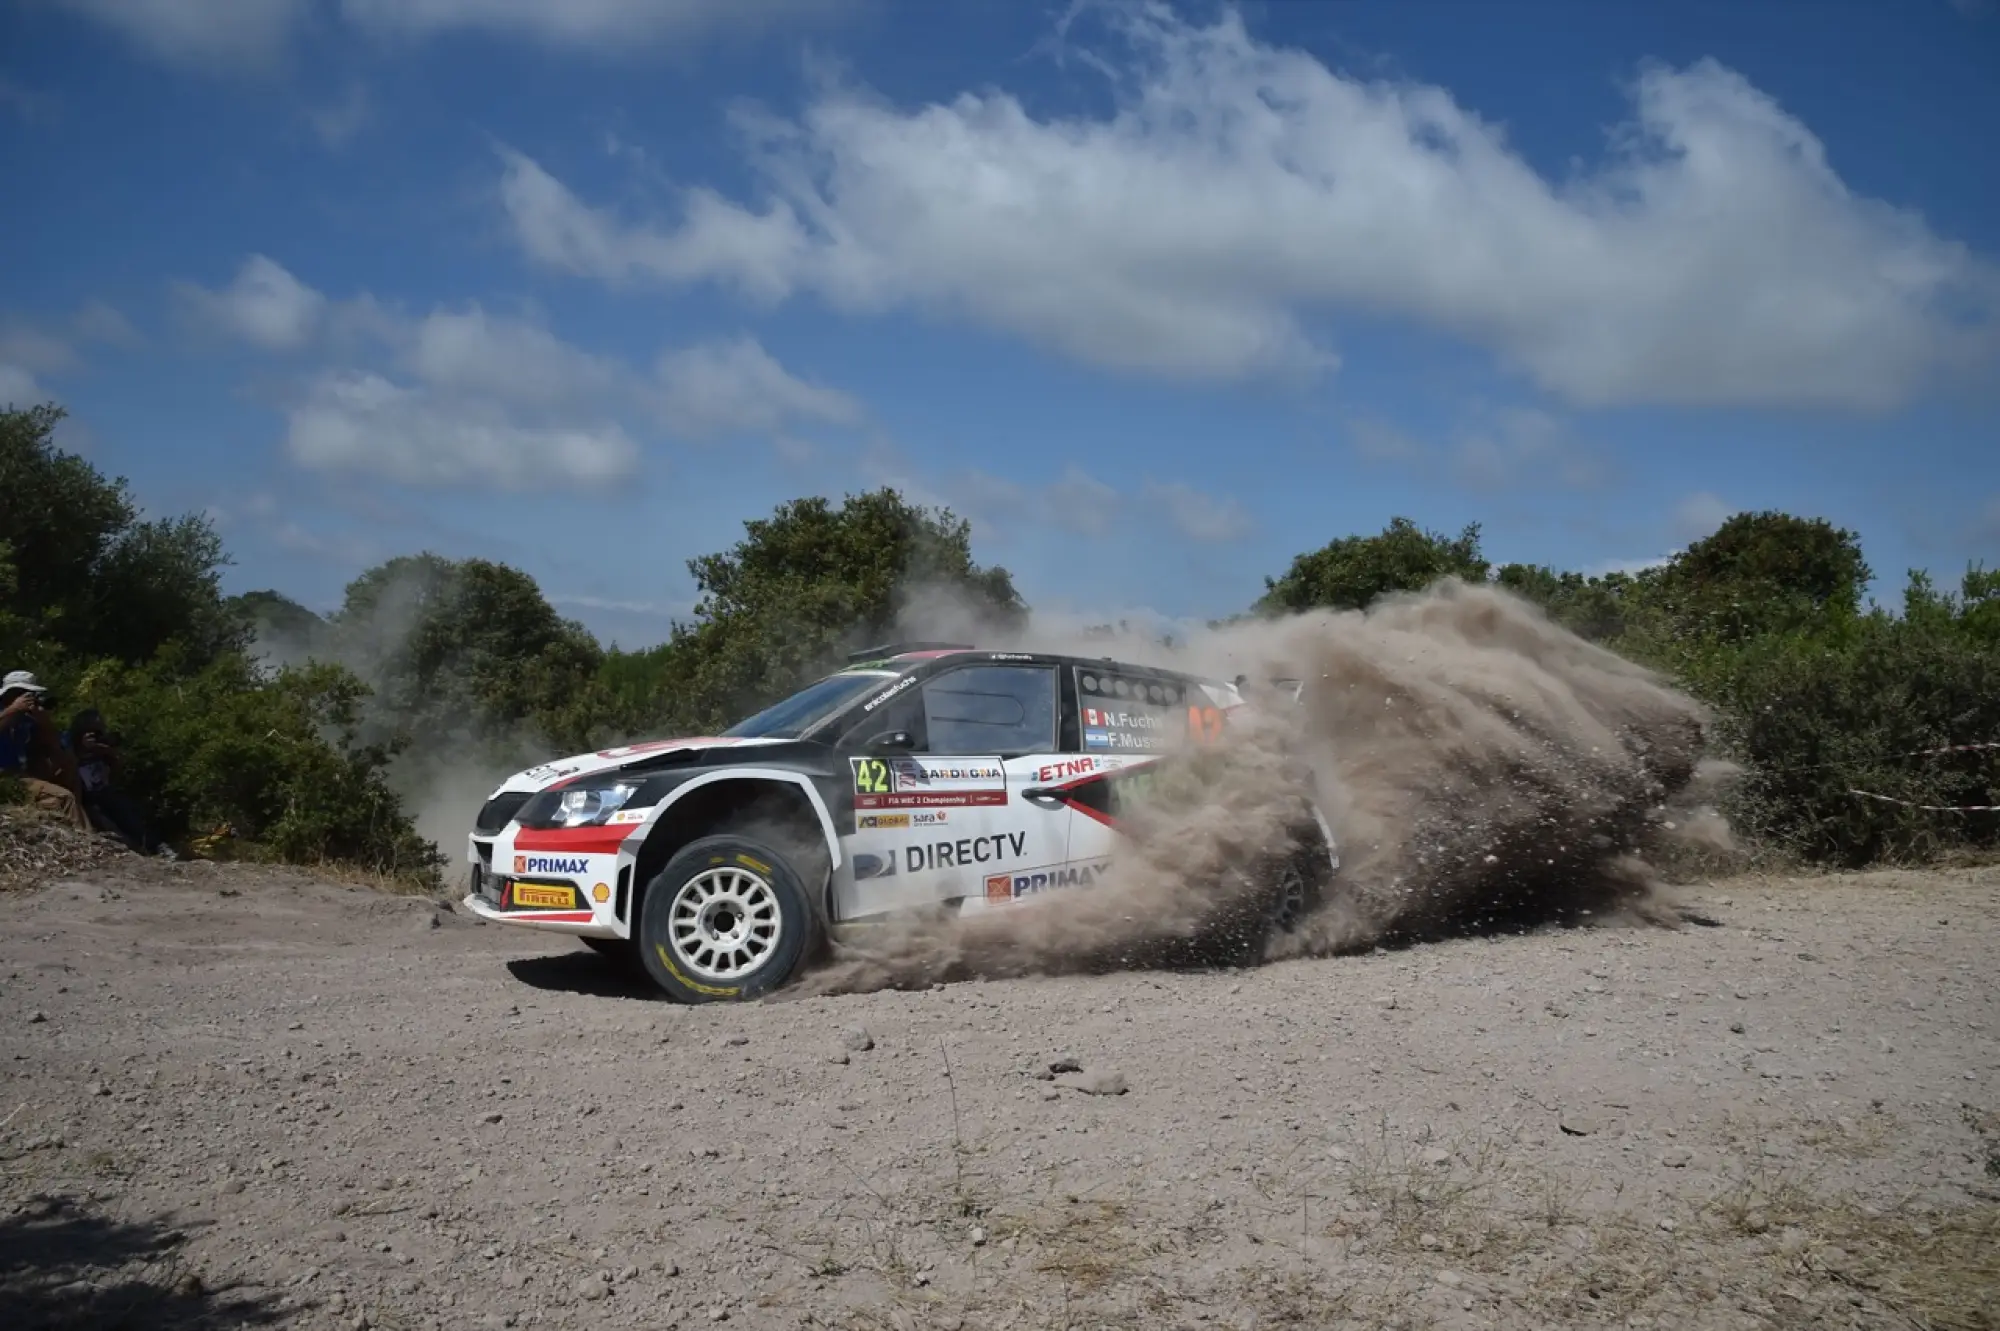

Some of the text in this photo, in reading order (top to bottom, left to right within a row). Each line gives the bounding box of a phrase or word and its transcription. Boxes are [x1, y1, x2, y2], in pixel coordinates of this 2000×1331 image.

[1104, 712, 1163, 728] N.Fuch
[857, 759, 889, 793] 42
[919, 768, 1001, 780] SARDEGNA
[1038, 757, 1095, 782] ETNA
[922, 796, 967, 806] Championship
[913, 814, 935, 823] sara
[527, 858, 589, 873] PRIMAX
[519, 888, 570, 905] PIRELLI
